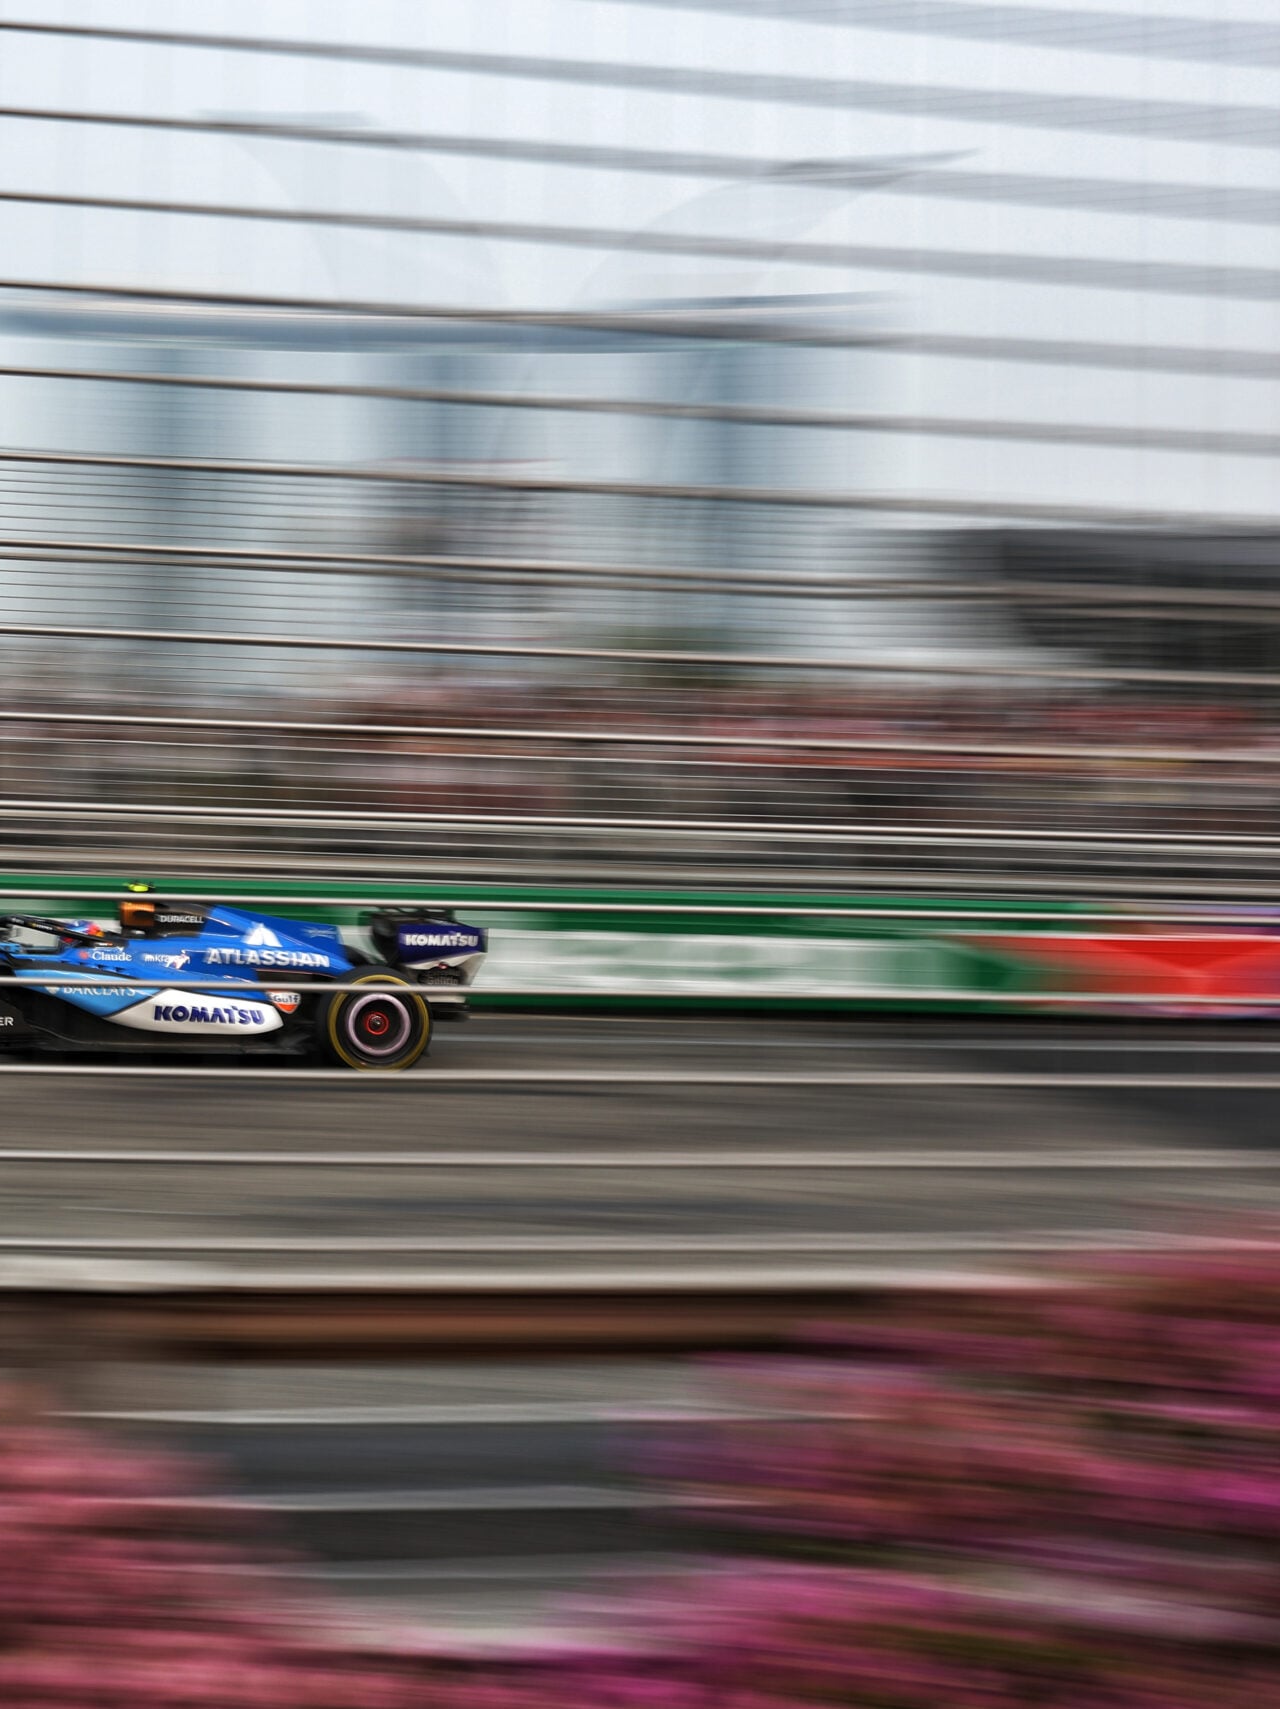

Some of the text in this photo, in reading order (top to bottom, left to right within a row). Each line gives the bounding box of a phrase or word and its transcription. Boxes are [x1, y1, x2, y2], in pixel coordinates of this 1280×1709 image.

[160, 914, 204, 923] DURACELL
[404, 931, 479, 947] KOMATSU
[92, 951, 132, 961] Claude
[206, 948, 330, 968] ATLASSIAN
[273, 994, 299, 1003] Gulf
[154, 1005, 265, 1025] KOMATSU
